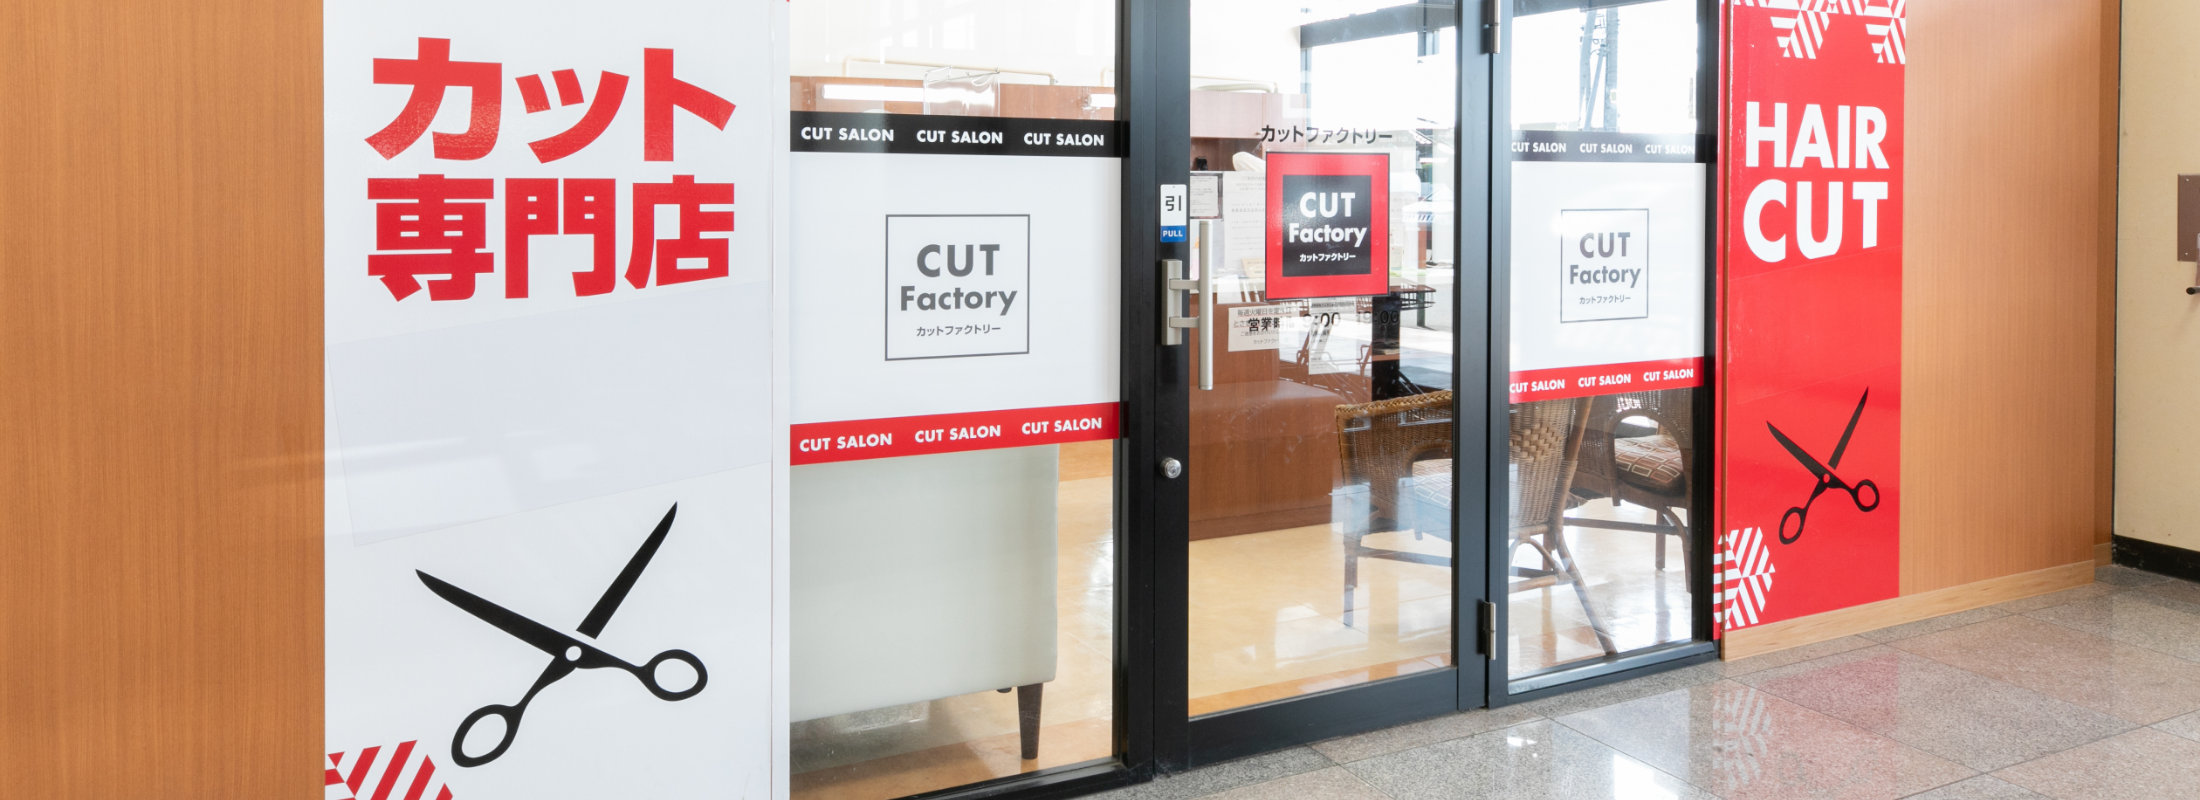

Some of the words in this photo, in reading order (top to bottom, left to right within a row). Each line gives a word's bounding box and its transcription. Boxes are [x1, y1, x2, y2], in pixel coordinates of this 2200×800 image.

[364, 37, 737, 164] カット
[800, 126, 833, 141] CUT
[838, 127, 894, 142] SALON
[916, 129, 946, 143] CUT
[951, 130, 1003, 144] SALON
[1023, 132, 1051, 146] CUT
[1056, 132, 1105, 147] SALON
[1261, 124, 1393, 144] カットファクトリー
[1745, 101, 1890, 169] HAIR
[1510, 142, 1530, 153] CUT
[1532, 142, 1567, 153] SALON
[1579, 142, 1598, 154] CUT
[1600, 143, 1633, 154] SALON
[1645, 144, 1661, 154] CUT
[1665, 144, 1695, 155] SALON
[1165, 195, 1182, 212] 引
[1299, 191, 1356, 217] CUT
[1162, 230, 1184, 238] PULL
[1743, 179, 1889, 263] CUT
[367, 174, 735, 302] 専門店
[1288, 222, 1367, 248] Factory
[1579, 232, 1631, 258] CUT
[916, 243, 1001, 278] CUT
[1299, 252, 1356, 263] カットファクトリー
[1569, 264, 1642, 289] Factory
[900, 285, 1018, 316] Factory
[1579, 294, 1632, 305] カットファクトリー
[916, 324, 1001, 337] カットファクトリー
[1509, 383, 1529, 394] CUT
[1531, 379, 1566, 392] SALON
[1577, 377, 1597, 388] CUT
[1599, 373, 1632, 386] SALON
[1642, 371, 1661, 382] CUT
[1662, 368, 1694, 381] SALON
[799, 438, 832, 453] CUT
[836, 432, 893, 450] SALON
[914, 429, 945, 443] CUT
[949, 424, 1001, 441] SALON
[1021, 421, 1050, 435] CUT
[1053, 417, 1103, 433] SALON
